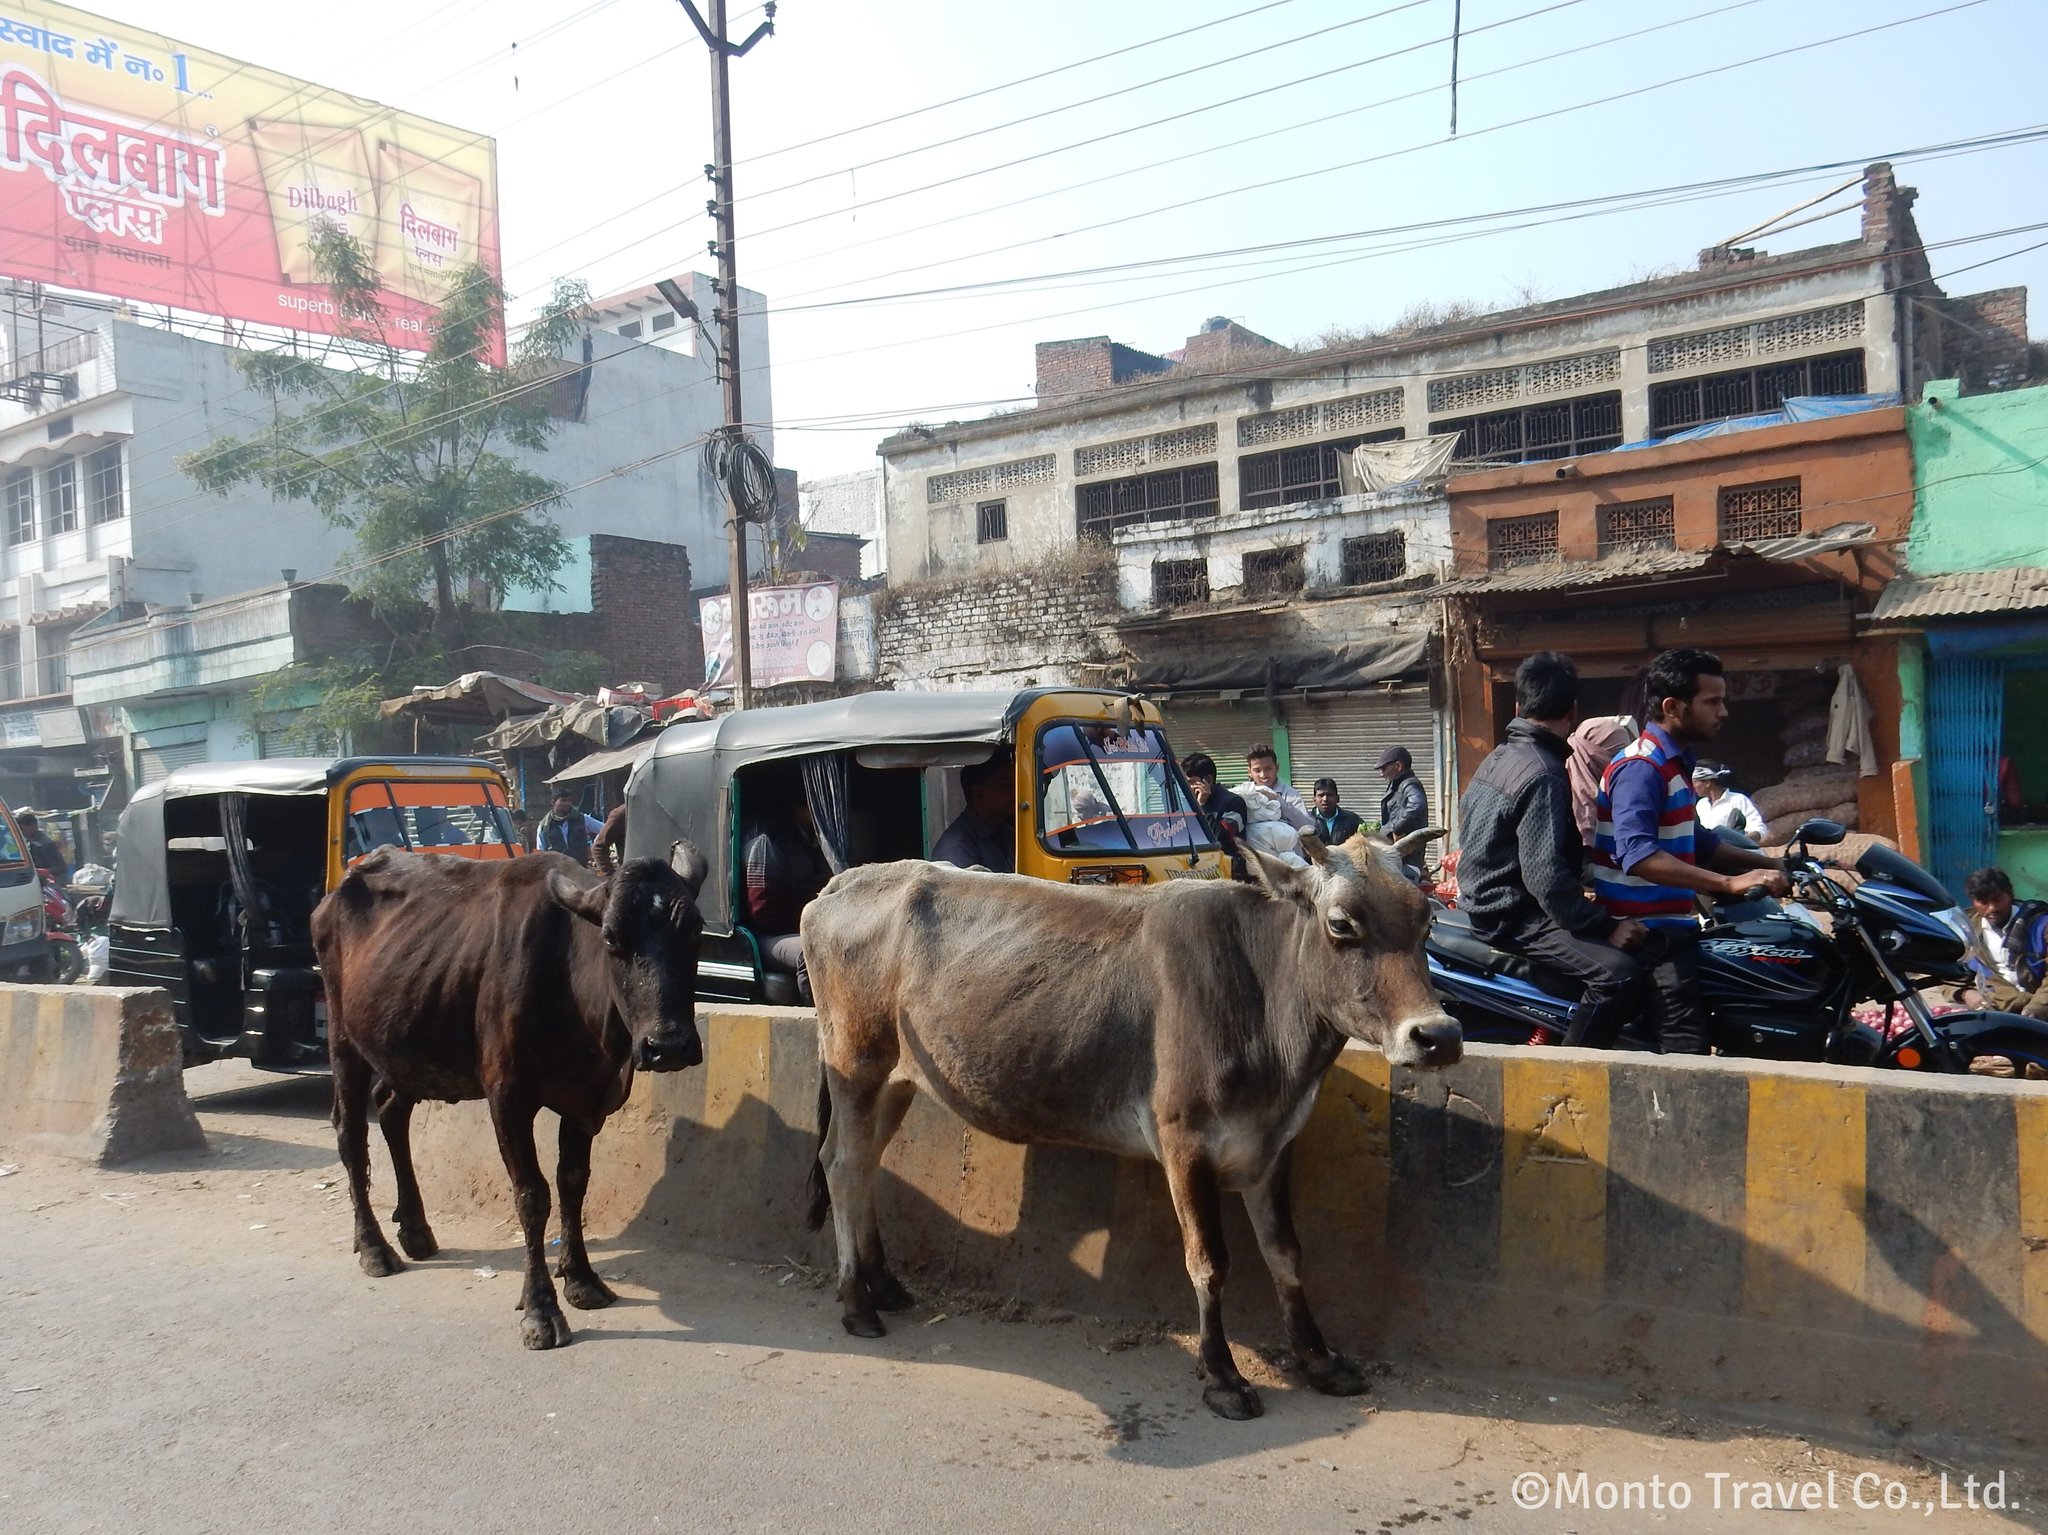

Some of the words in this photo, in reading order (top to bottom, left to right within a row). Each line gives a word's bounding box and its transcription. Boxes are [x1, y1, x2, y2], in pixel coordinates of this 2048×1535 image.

[0, 17, 76, 59] स्वाद
[84, 38, 118, 70] में
[0, 70, 221, 209] दिलबाग
[288, 187, 358, 216] Dilbagh
[400, 203, 458, 252] दिलबाग
[415, 246, 443, 267] प्लस
[278, 293, 334, 316] superb
[395, 317, 423, 333] real
